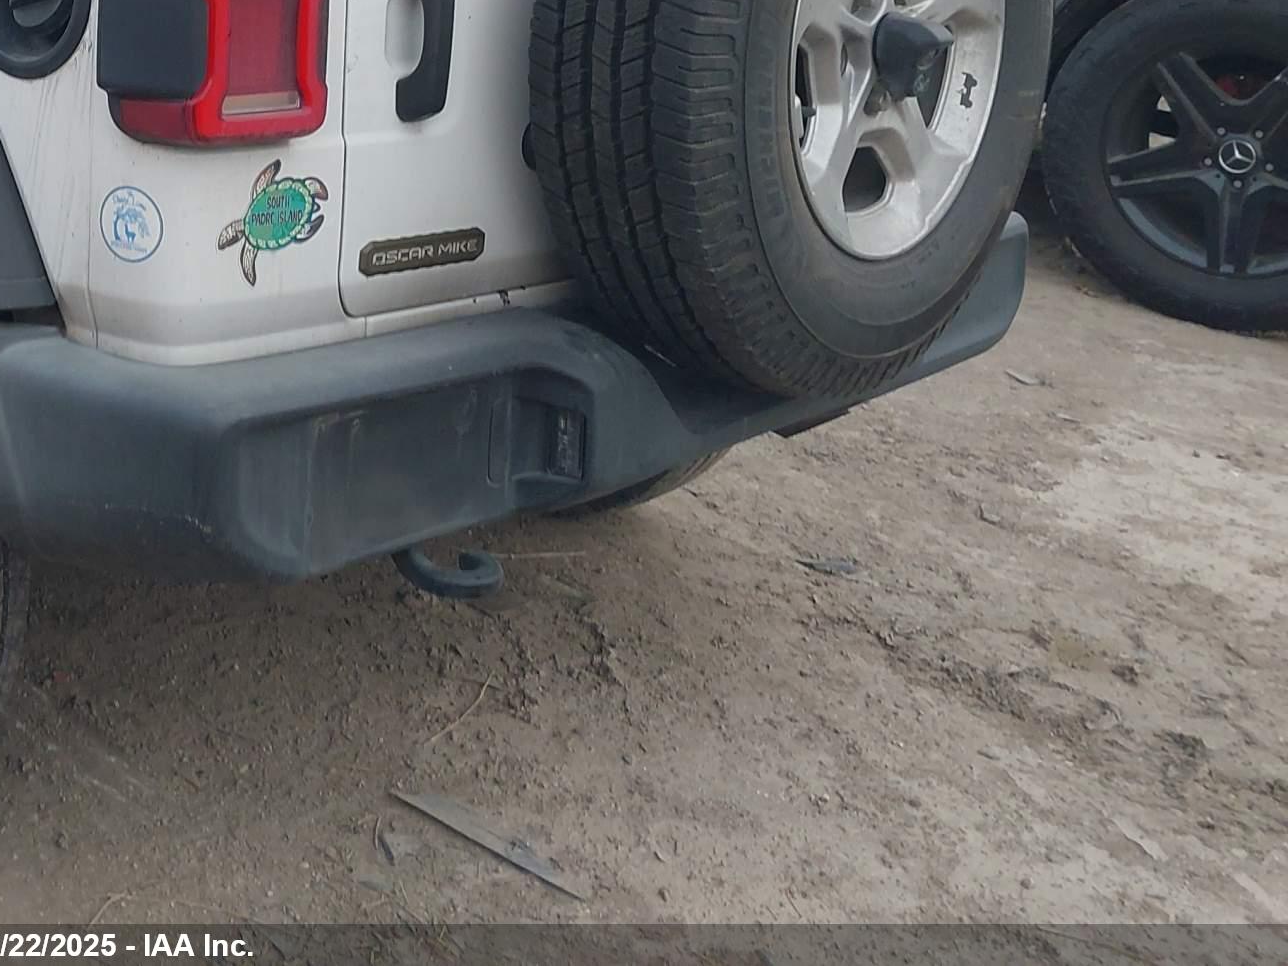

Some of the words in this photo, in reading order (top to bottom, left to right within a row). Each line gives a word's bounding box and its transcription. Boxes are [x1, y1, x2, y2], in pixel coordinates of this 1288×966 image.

[267, 195, 290, 209] SOUTH
[278, 209, 303, 224] ISLAND
[372, 244, 434, 266] OSCAR
[437, 238, 478, 256] MIKE
